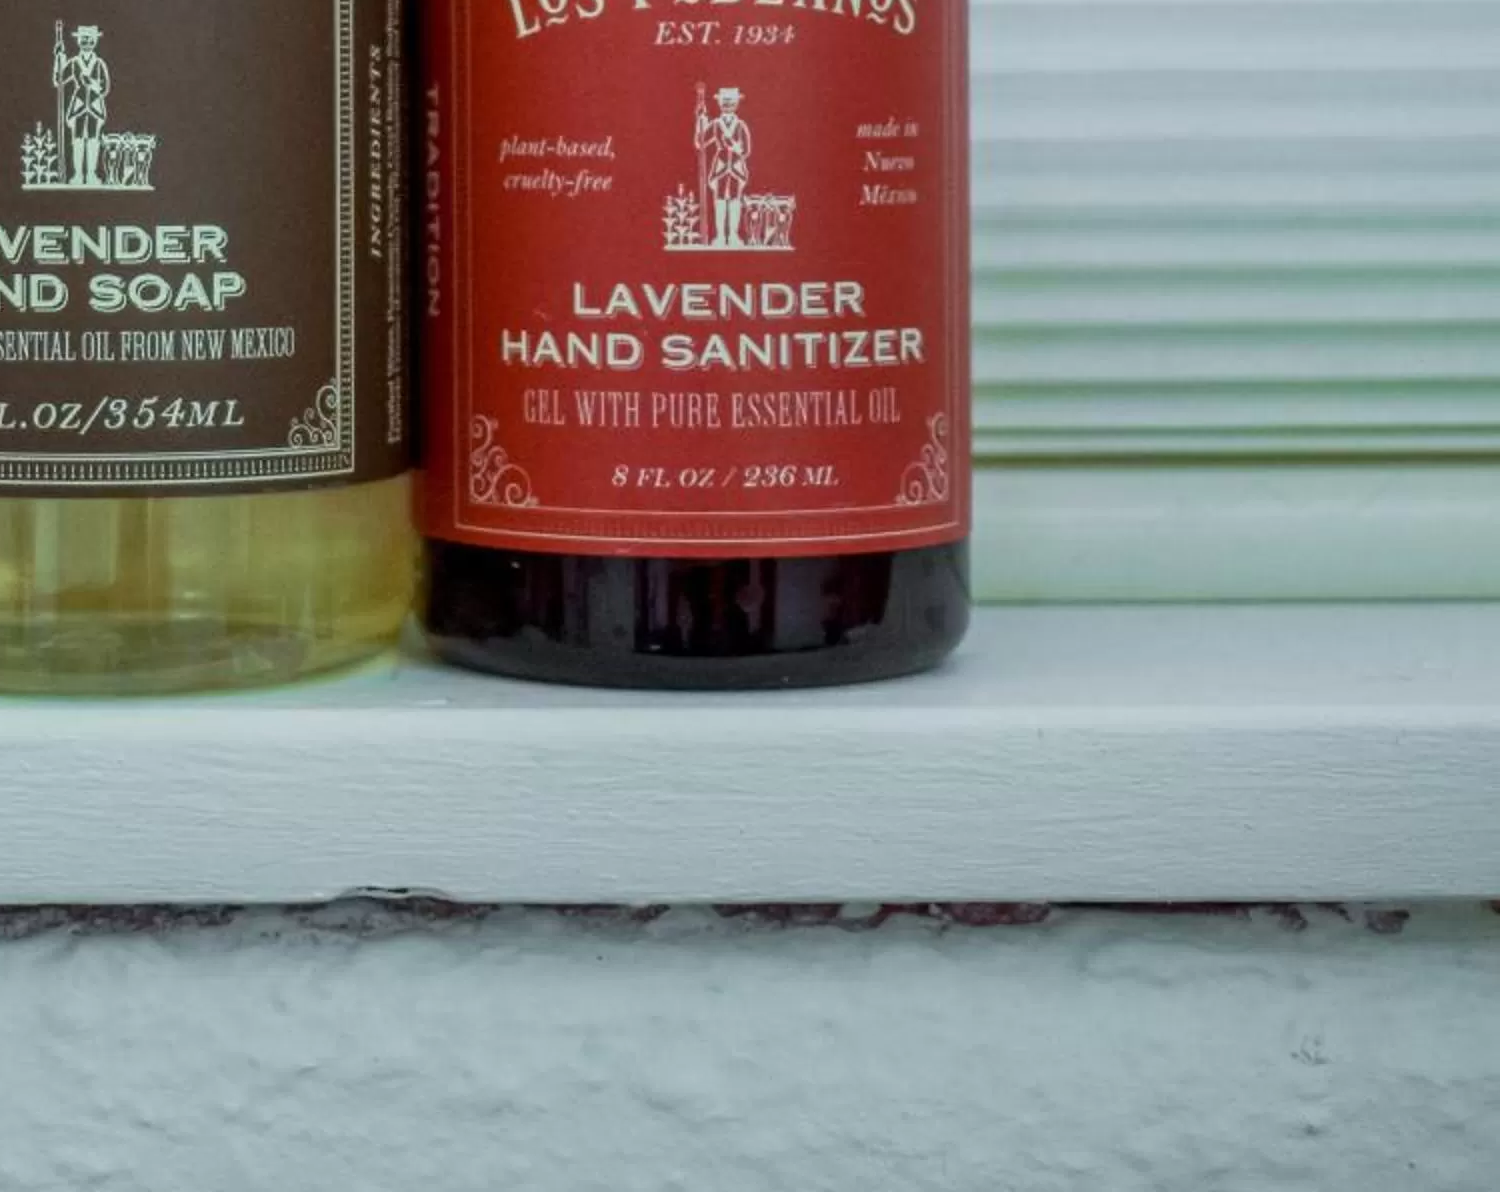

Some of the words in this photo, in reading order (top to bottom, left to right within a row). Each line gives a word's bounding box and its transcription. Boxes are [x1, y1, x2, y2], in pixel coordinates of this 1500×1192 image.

[655, 21, 721, 45] EST.
[733, 21, 797, 45] 1934
[369, 44, 382, 258] INGREDIENTS
[426, 82, 440, 317] TRADITION
[503, 168, 613, 200] cruelty-free
[89, 272, 246, 313] SOAP
[572, 282, 865, 319] LAVENDER
[80, 329, 115, 361] OIL
[120, 329, 175, 361] FROM
[181, 328, 226, 360] NEW
[230, 327, 295, 359] MEXICO
[501, 329, 644, 370] HAND
[660, 327, 925, 370] SANITIZER
[523, 388, 565, 425] GEL
[573, 390, 640, 427] WITH
[651, 392, 721, 429] PURE
[731, 390, 862, 428] ESSENTIAL
[868, 386, 901, 424] OIL
[611, 464, 629, 488] 8
[636, 468, 671, 488] FL
[678, 468, 715, 488] OZ
[721, 467, 738, 488] /
[742, 464, 797, 489] 236
[802, 465, 841, 488] ML
